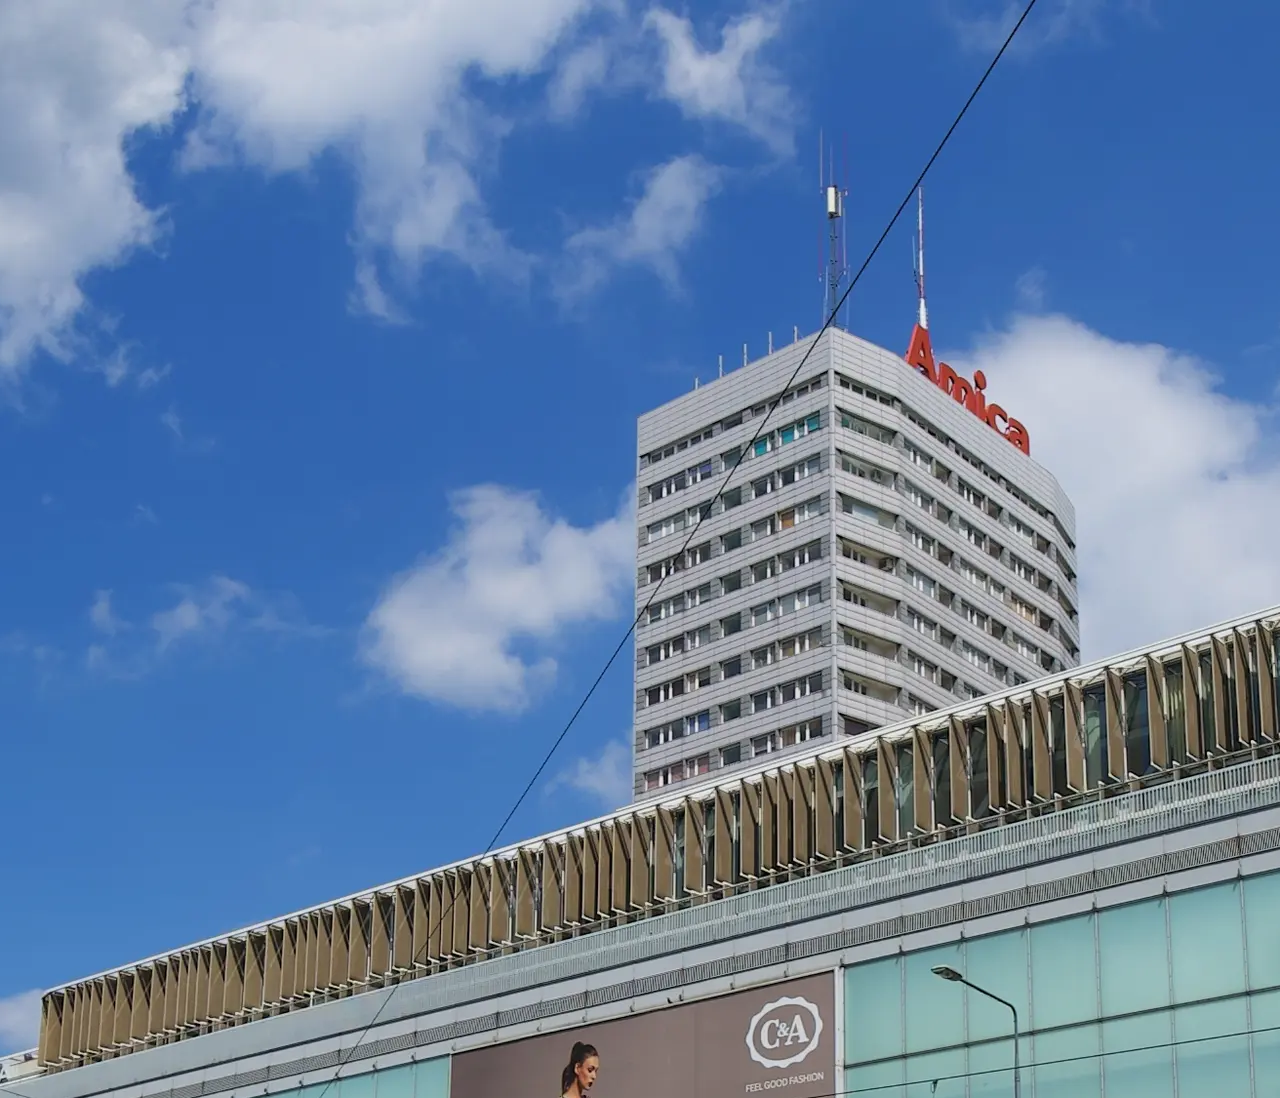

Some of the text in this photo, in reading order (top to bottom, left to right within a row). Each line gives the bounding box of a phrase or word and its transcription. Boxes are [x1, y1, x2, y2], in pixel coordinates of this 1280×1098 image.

[905, 323, 1030, 457] Amica
[760, 1014, 810, 1049] C&A
[745, 1071, 825, 1093] FEEL GOOD FASHION
